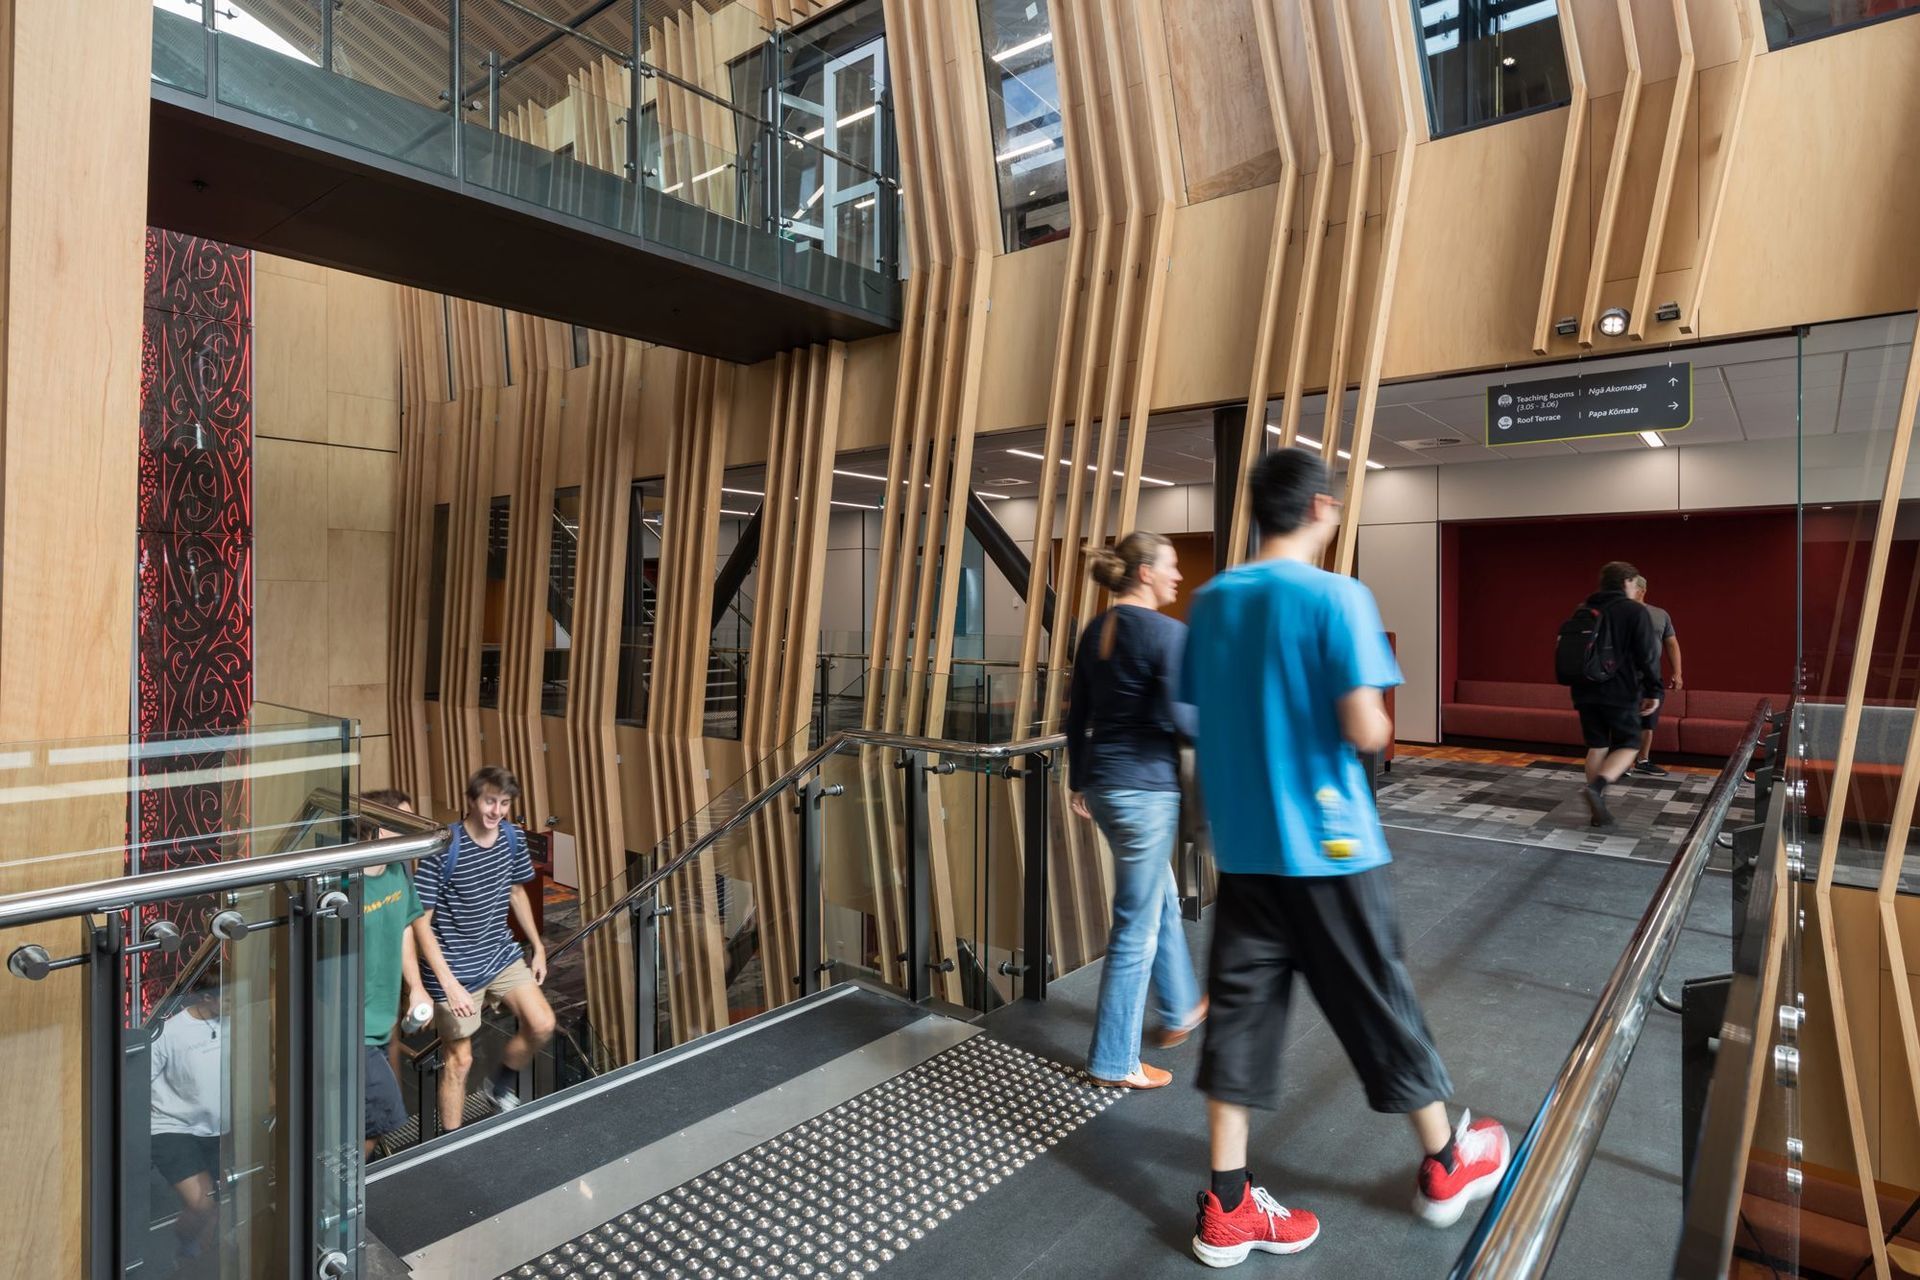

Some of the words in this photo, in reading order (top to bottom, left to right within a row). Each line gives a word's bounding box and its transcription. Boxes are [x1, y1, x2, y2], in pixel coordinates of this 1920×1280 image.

[1605, 383, 1647, 393] Akomanga
[1517, 394, 1548, 403] Teaching
[1550, 391, 1575, 399] Rooms
[1588, 410, 1607, 418] Papa
[1608, 407, 1639, 416] Kōmata
[1517, 416, 1534, 424] Roof
[1535, 414, 1561, 422] Terrace
